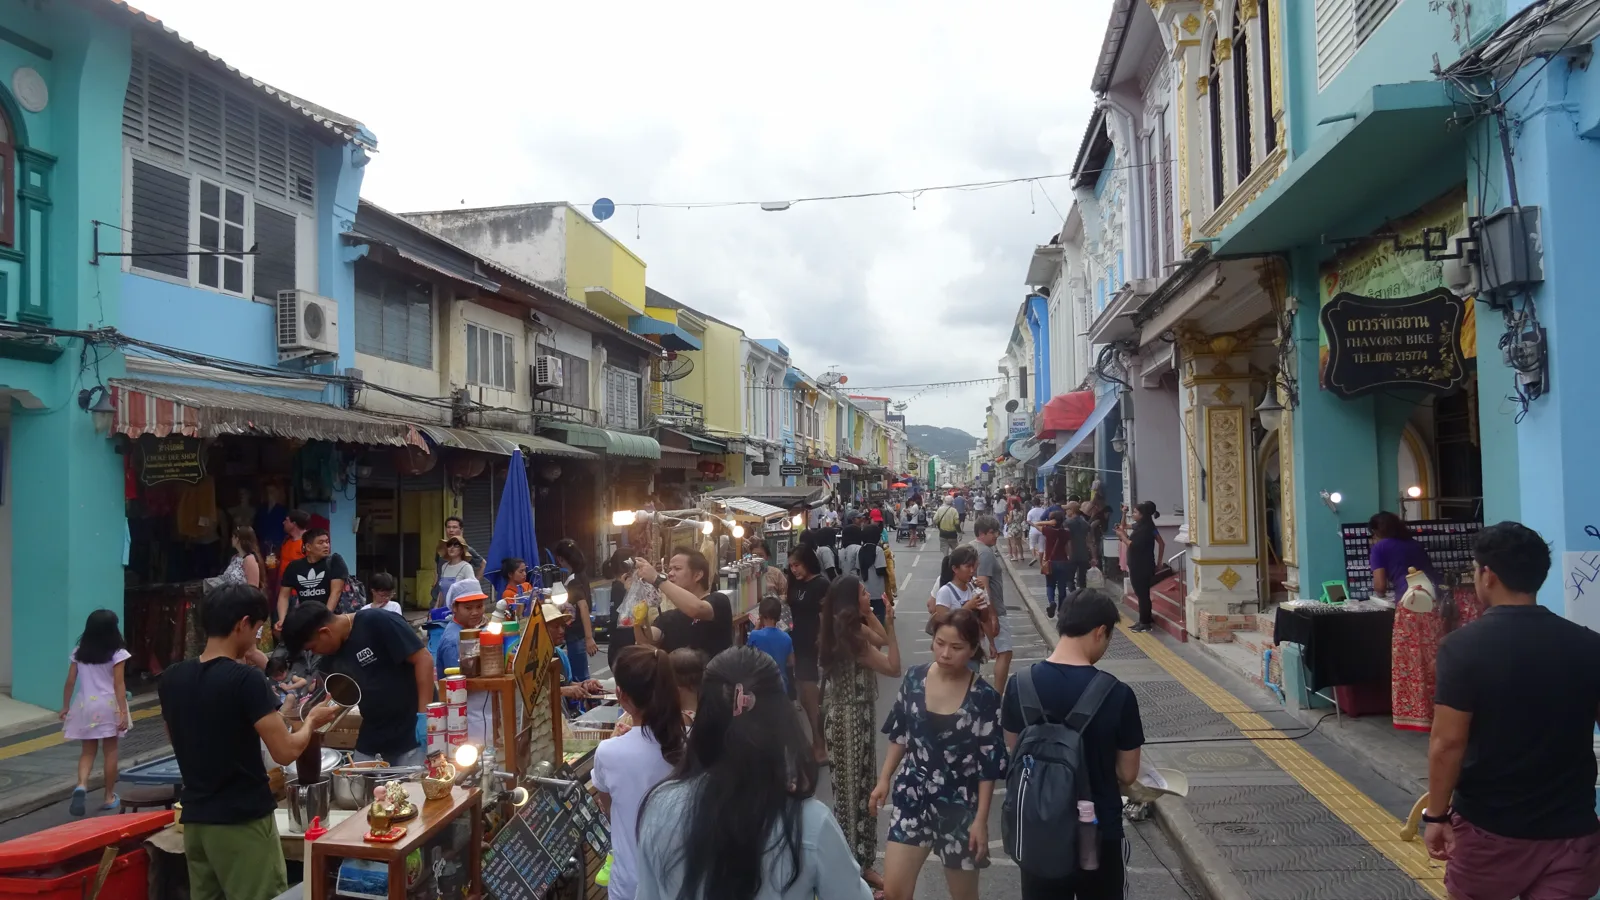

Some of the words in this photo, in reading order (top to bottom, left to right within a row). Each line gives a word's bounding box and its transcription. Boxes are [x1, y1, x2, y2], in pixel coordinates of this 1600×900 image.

[1347, 313, 1430, 332] ถาวรจักรยาน
[1345, 335, 1402, 348] THAVORN
[1406, 333, 1434, 345] BIKE
[1395, 350, 1428, 361] 215774
[299, 588, 326, 597] adidas
